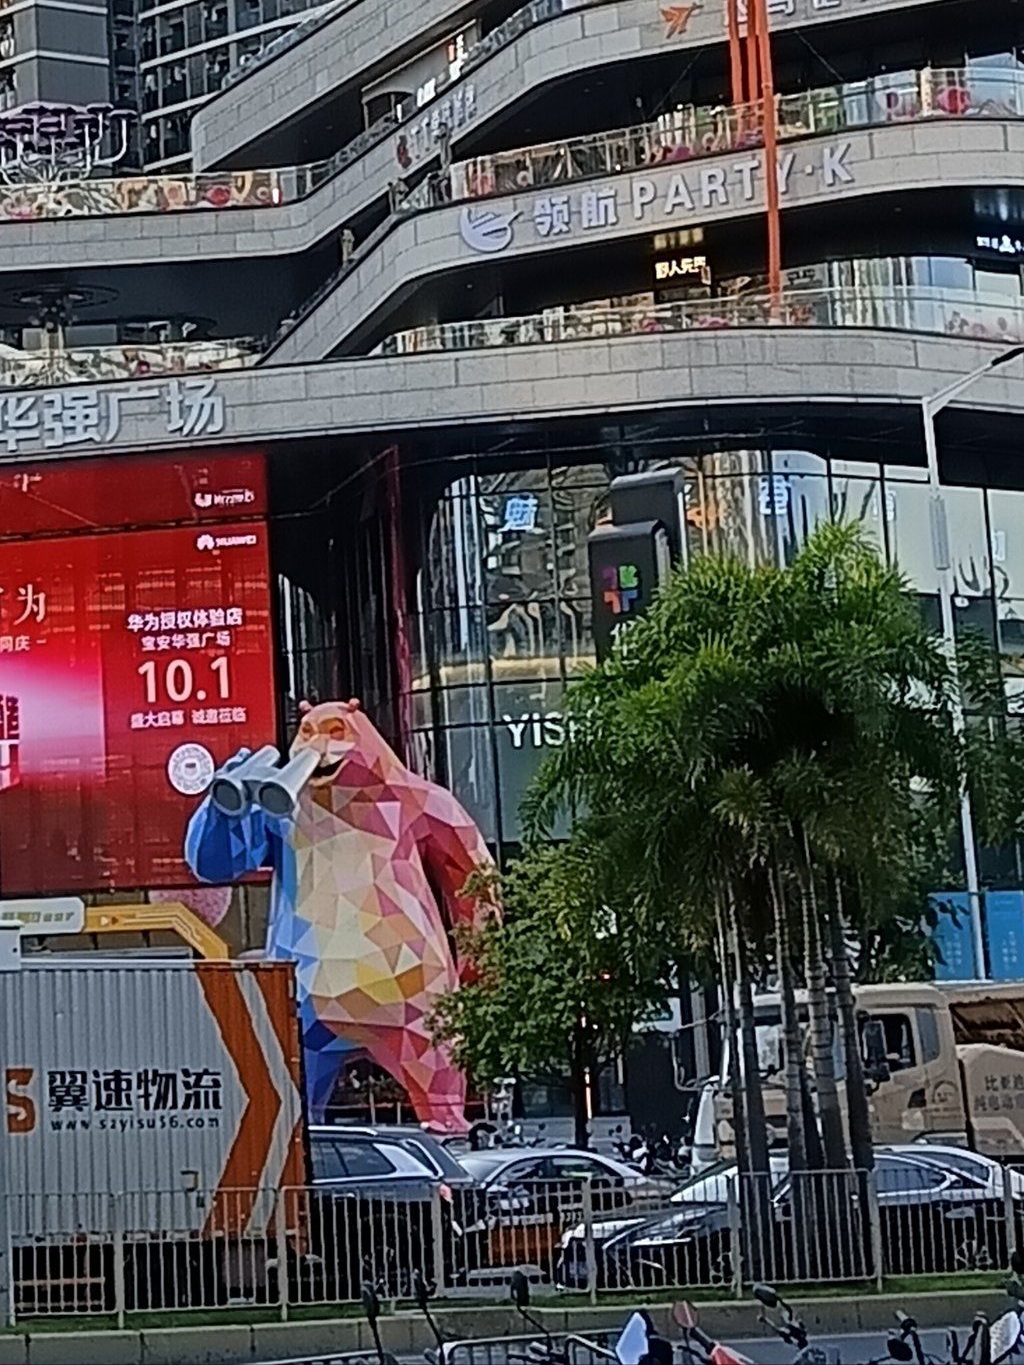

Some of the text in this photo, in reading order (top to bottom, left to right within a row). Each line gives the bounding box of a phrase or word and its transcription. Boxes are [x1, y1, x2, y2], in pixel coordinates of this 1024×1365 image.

[127, 608, 242, 632] 华为授权体验店
[141, 631, 231, 652] 宝安华强广场
[138, 656, 229, 703] 10.1
[47, 1068, 222, 1112] 翼速物流
